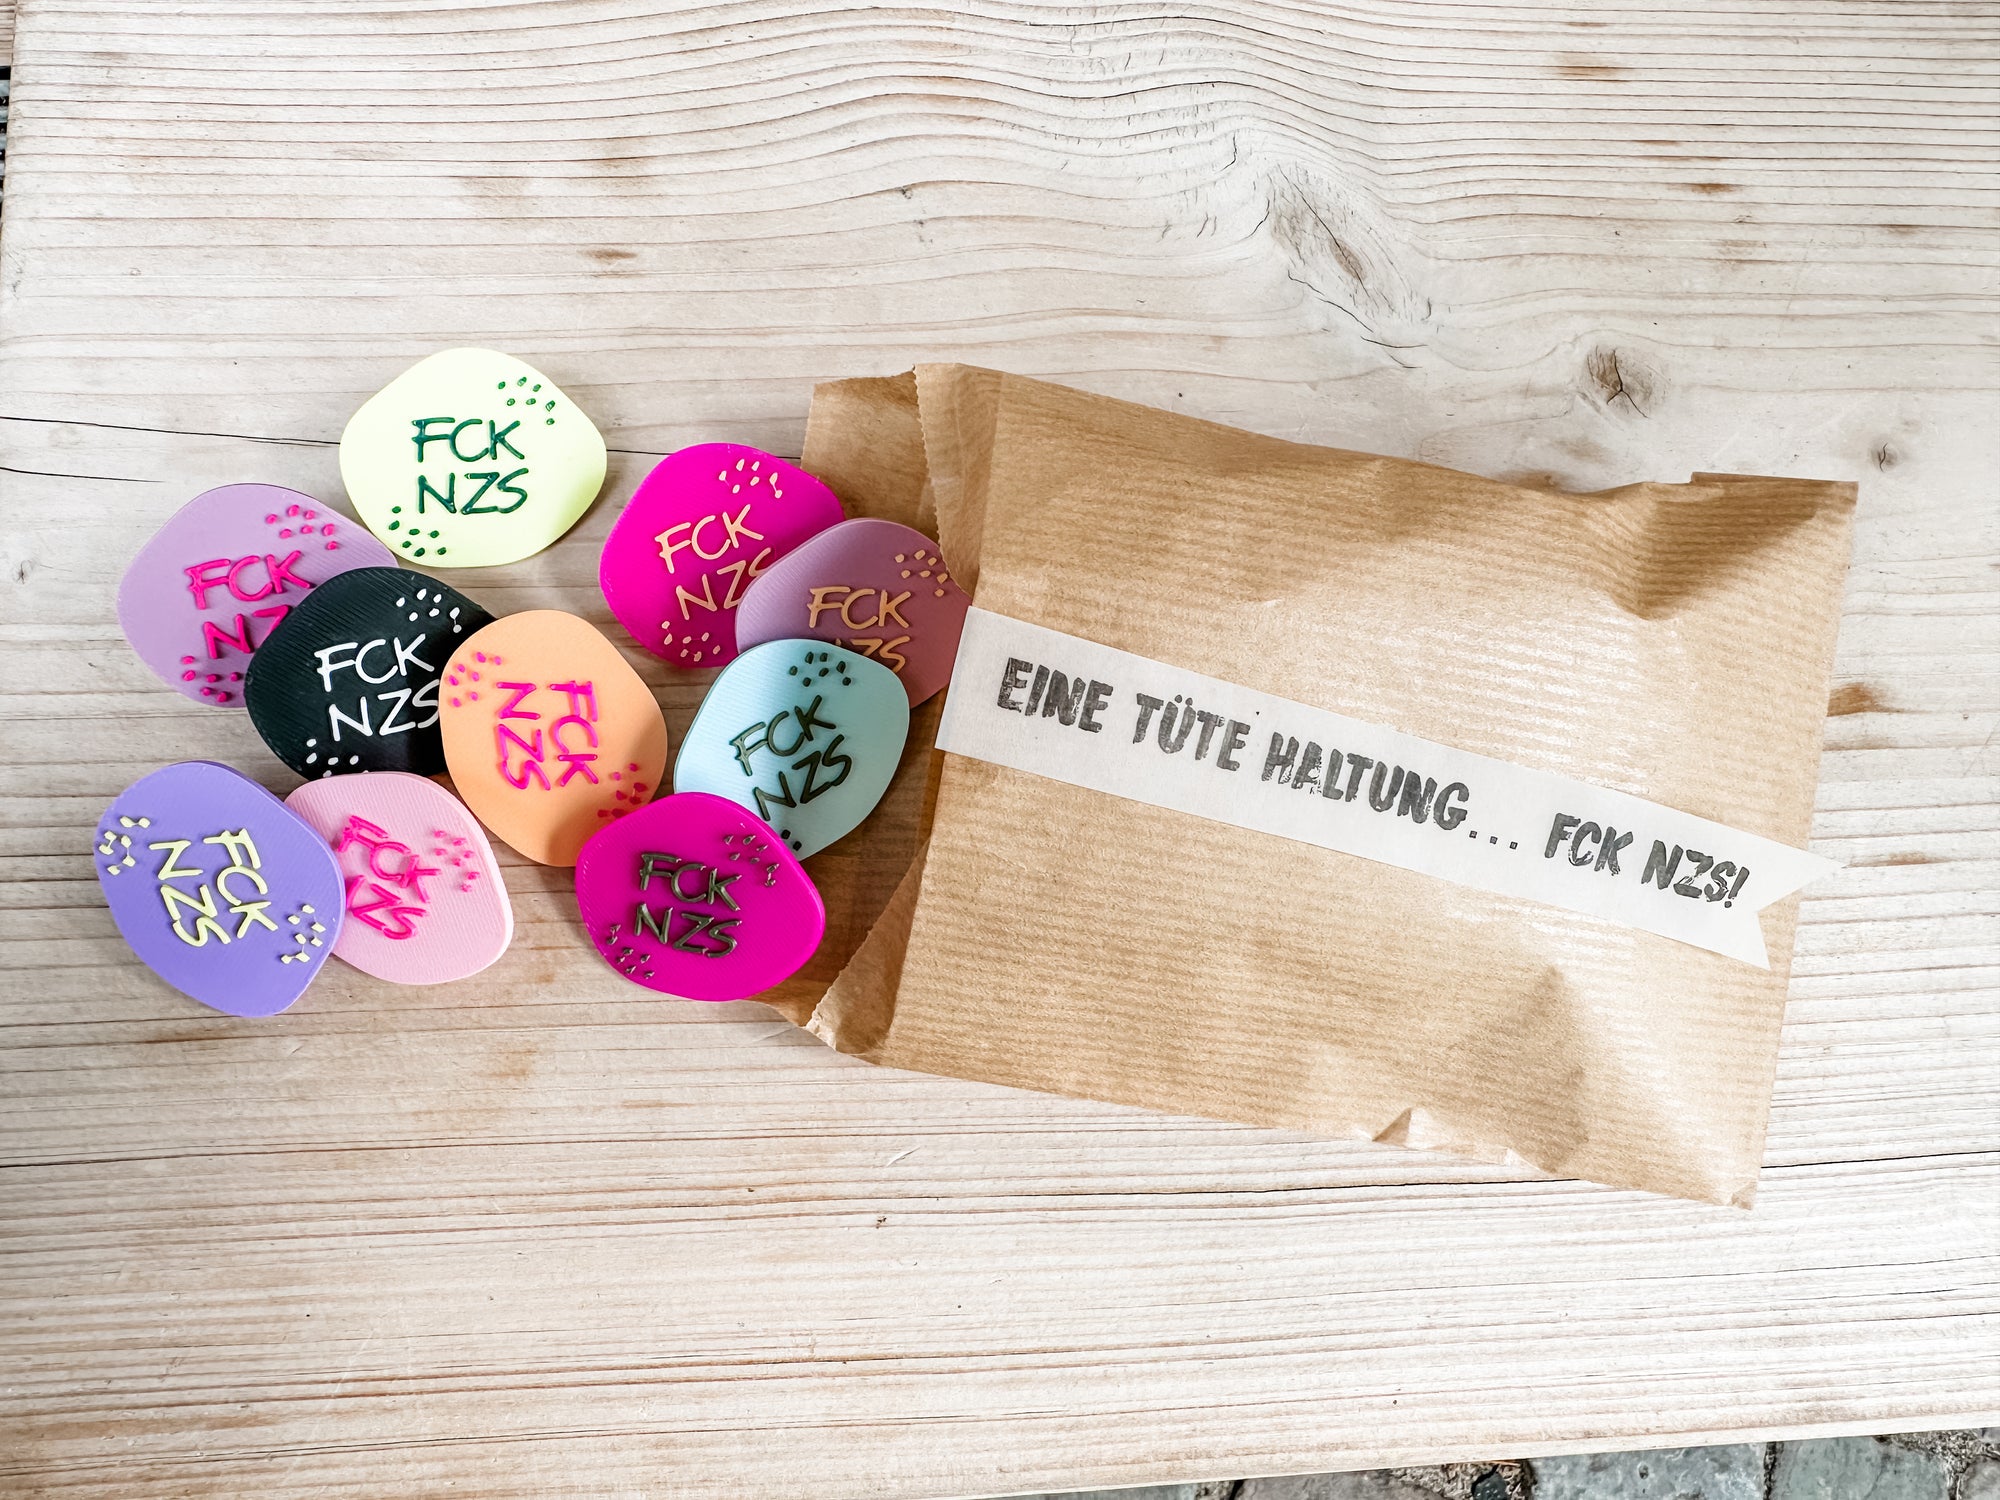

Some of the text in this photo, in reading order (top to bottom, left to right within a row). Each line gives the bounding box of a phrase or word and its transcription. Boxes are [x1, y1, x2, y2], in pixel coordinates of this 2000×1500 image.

[412, 417, 524, 463] FCK
[418, 467, 528, 515] NZS
[655, 504, 764, 574] FCK
[185, 550, 311, 610] FCK
[807, 585, 911, 630] FCK
[203, 604, 290, 659] NZ
[314, 633, 434, 692] FCK
[831, 636, 911, 674] ZS
[328, 679, 439, 742] NZS
[496, 681, 551, 791] NZS
[550, 680, 599, 786] FCK
[729, 695, 836, 777] FCK
[753, 734, 853, 822] NZS
[996, 656, 1750, 908] EINE TÜTE HALTUNG... FCK NZS!
[203, 828, 278, 939] FCK
[336, 815, 442, 903] FCK
[639, 851, 742, 912] FCK
[149, 839, 231, 947] NZS
[346, 874, 429, 940] NZS
[633, 902, 742, 959] NZS
